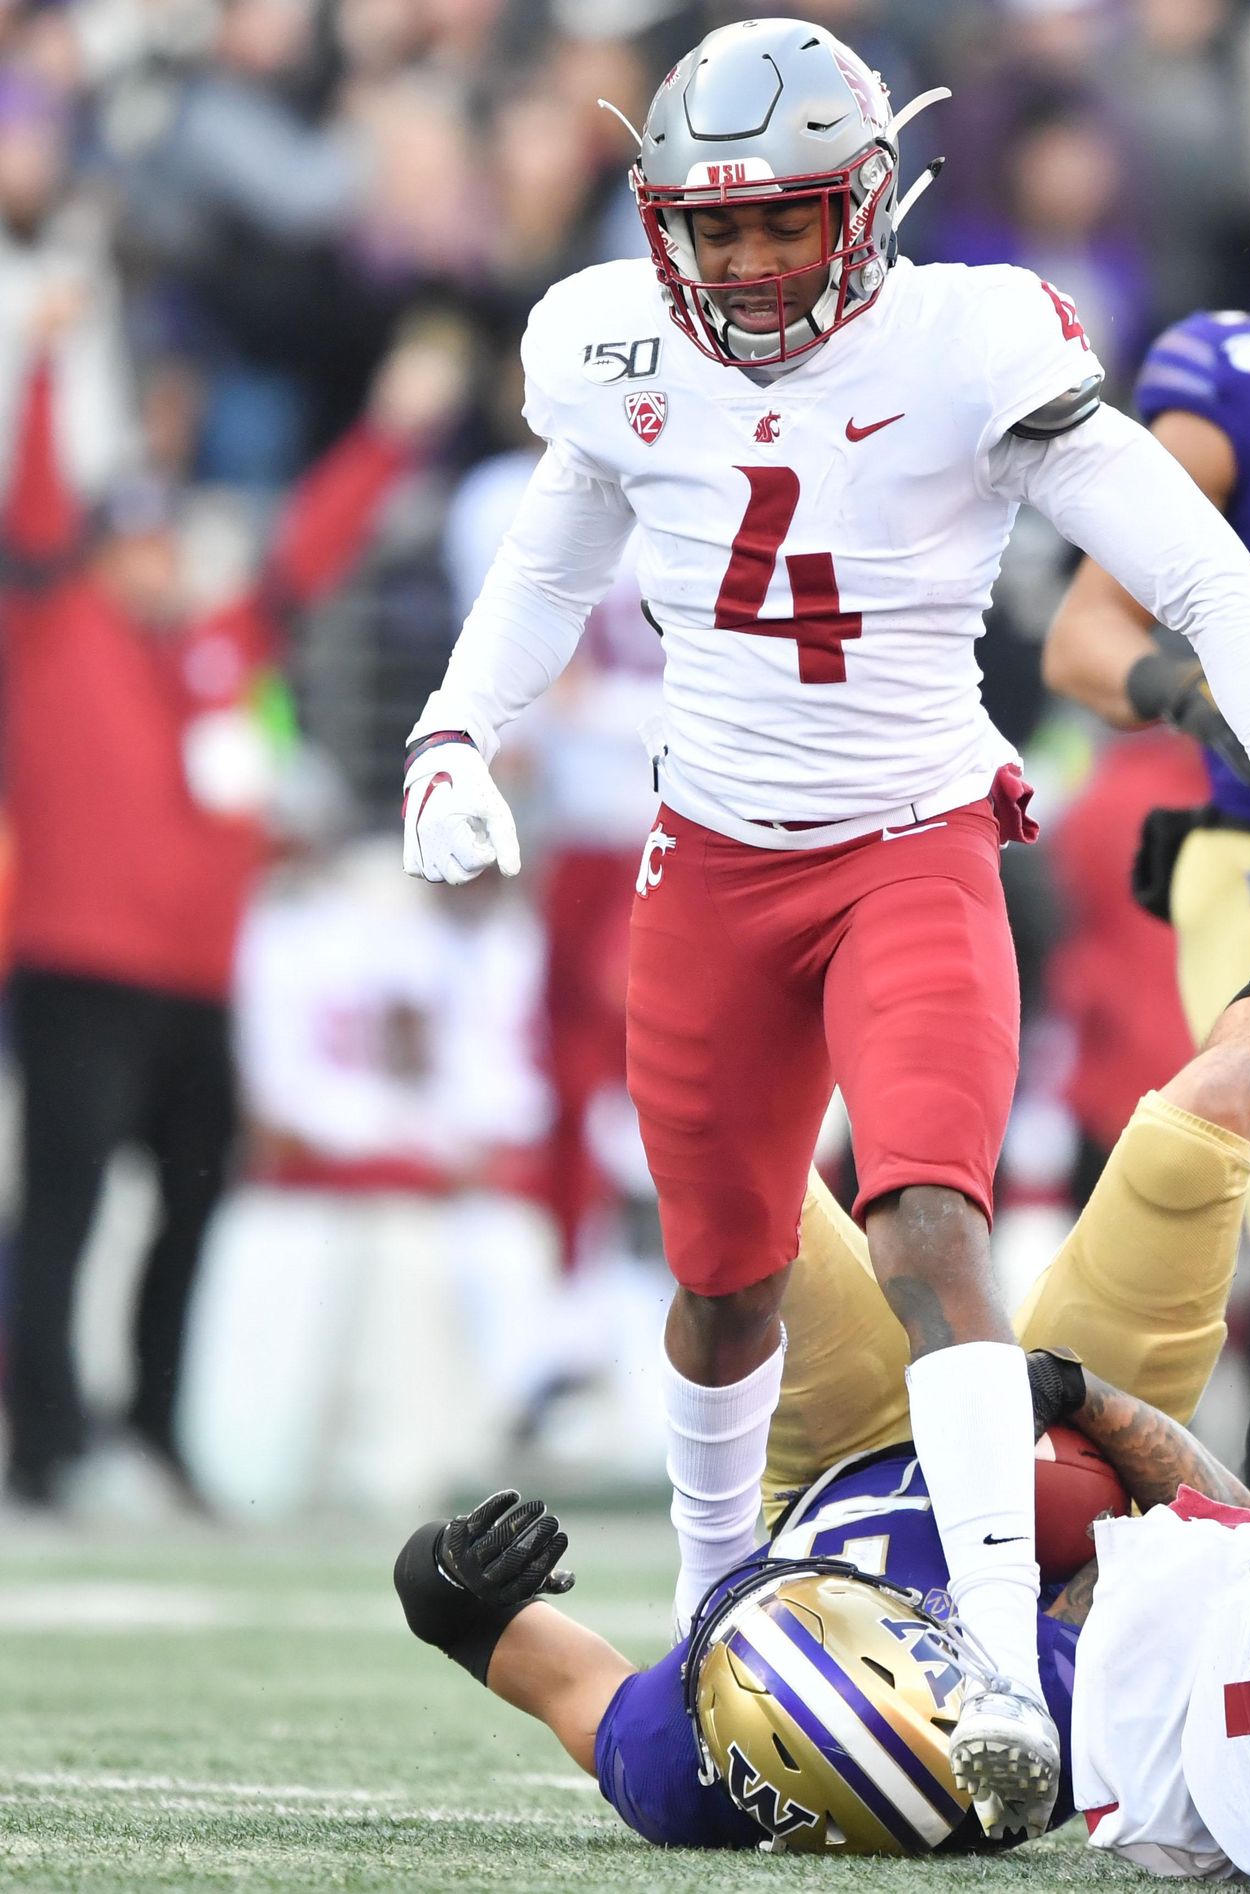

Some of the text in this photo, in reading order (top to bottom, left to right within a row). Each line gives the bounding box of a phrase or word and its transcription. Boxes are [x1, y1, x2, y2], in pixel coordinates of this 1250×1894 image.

[706, 163, 746, 184] WSU
[1040, 281, 1089, 351] 4
[581, 336, 661, 383] 150
[625, 391, 666, 425] PAC
[636, 412, 659, 434] 12
[714, 465, 862, 684] 4
[728, 1740, 821, 1838] W
